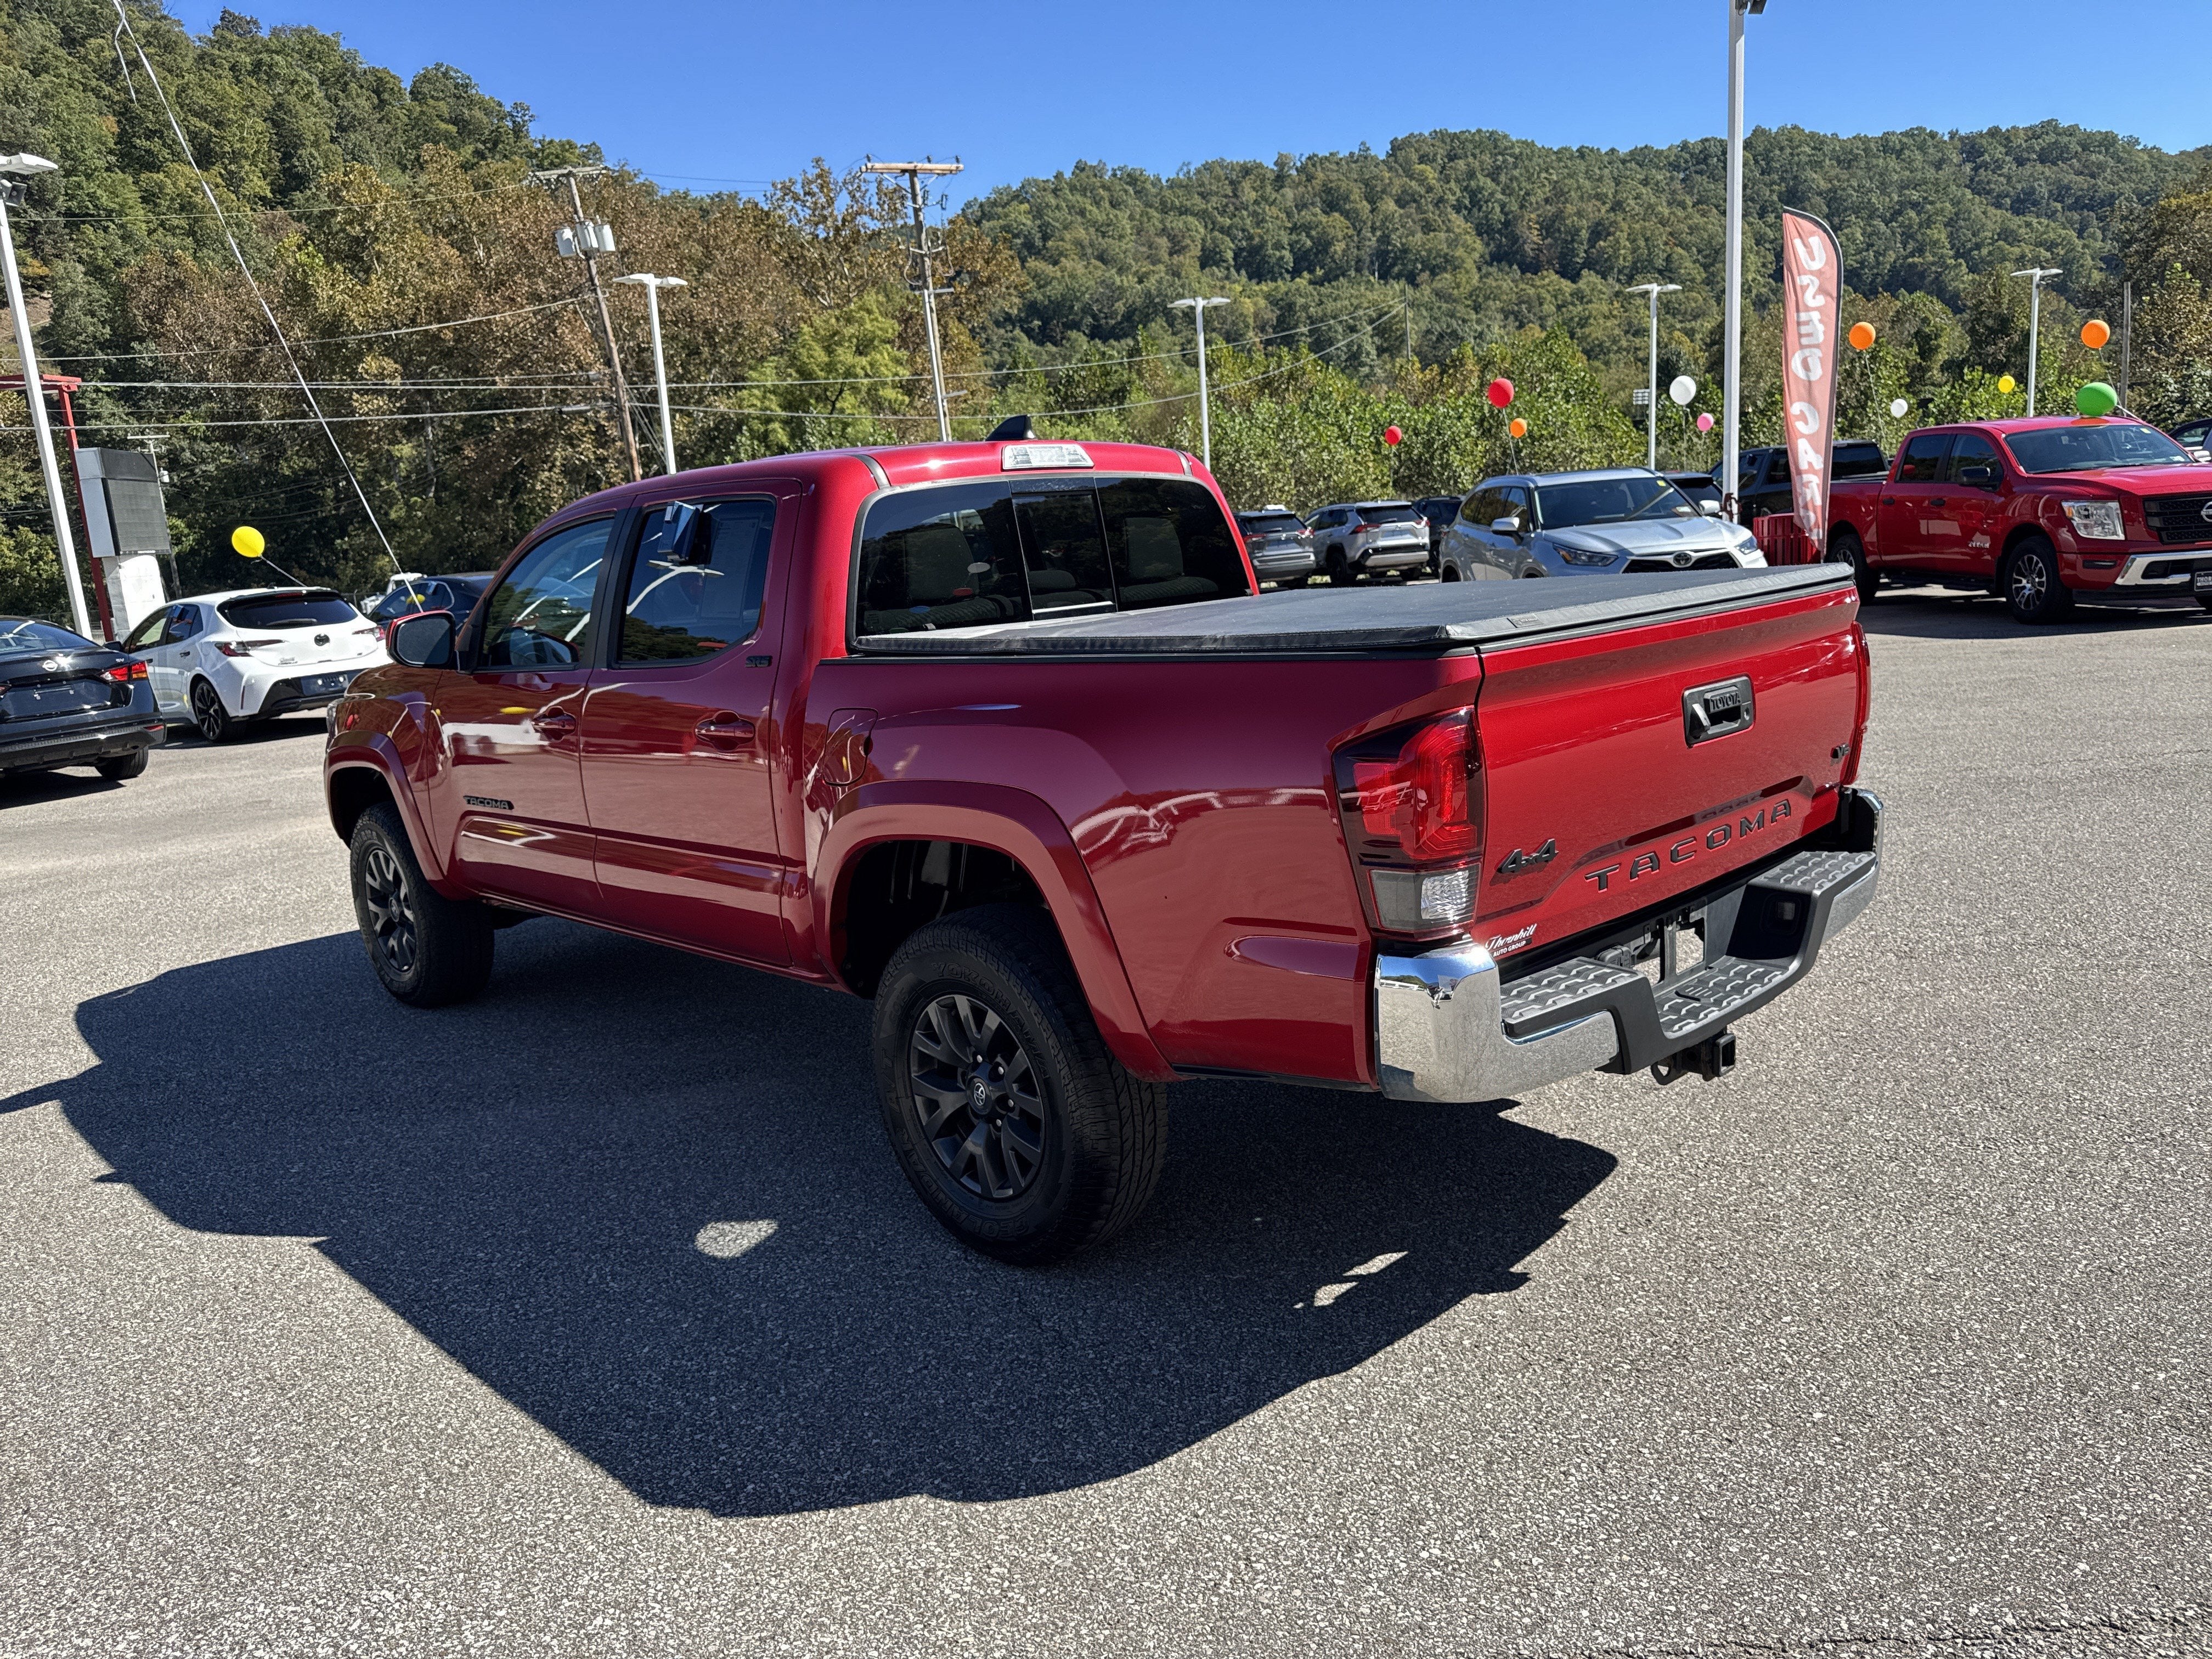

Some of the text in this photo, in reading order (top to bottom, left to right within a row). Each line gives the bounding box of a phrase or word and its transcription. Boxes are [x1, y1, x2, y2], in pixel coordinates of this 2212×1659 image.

[1710, 692, 1741, 710] TOYOTA
[464, 796, 510, 810] TACOMA
[1496, 838, 1559, 873] 4x4
[1584, 799, 1791, 893] TACOMA
[1485, 923, 1537, 951] Thornhill
[1493, 940, 1526, 957] AUTO GROUP
[931, 961, 1051, 1080] YOKOHAMA
[896, 1127, 1029, 1238] GEOLANDAR
